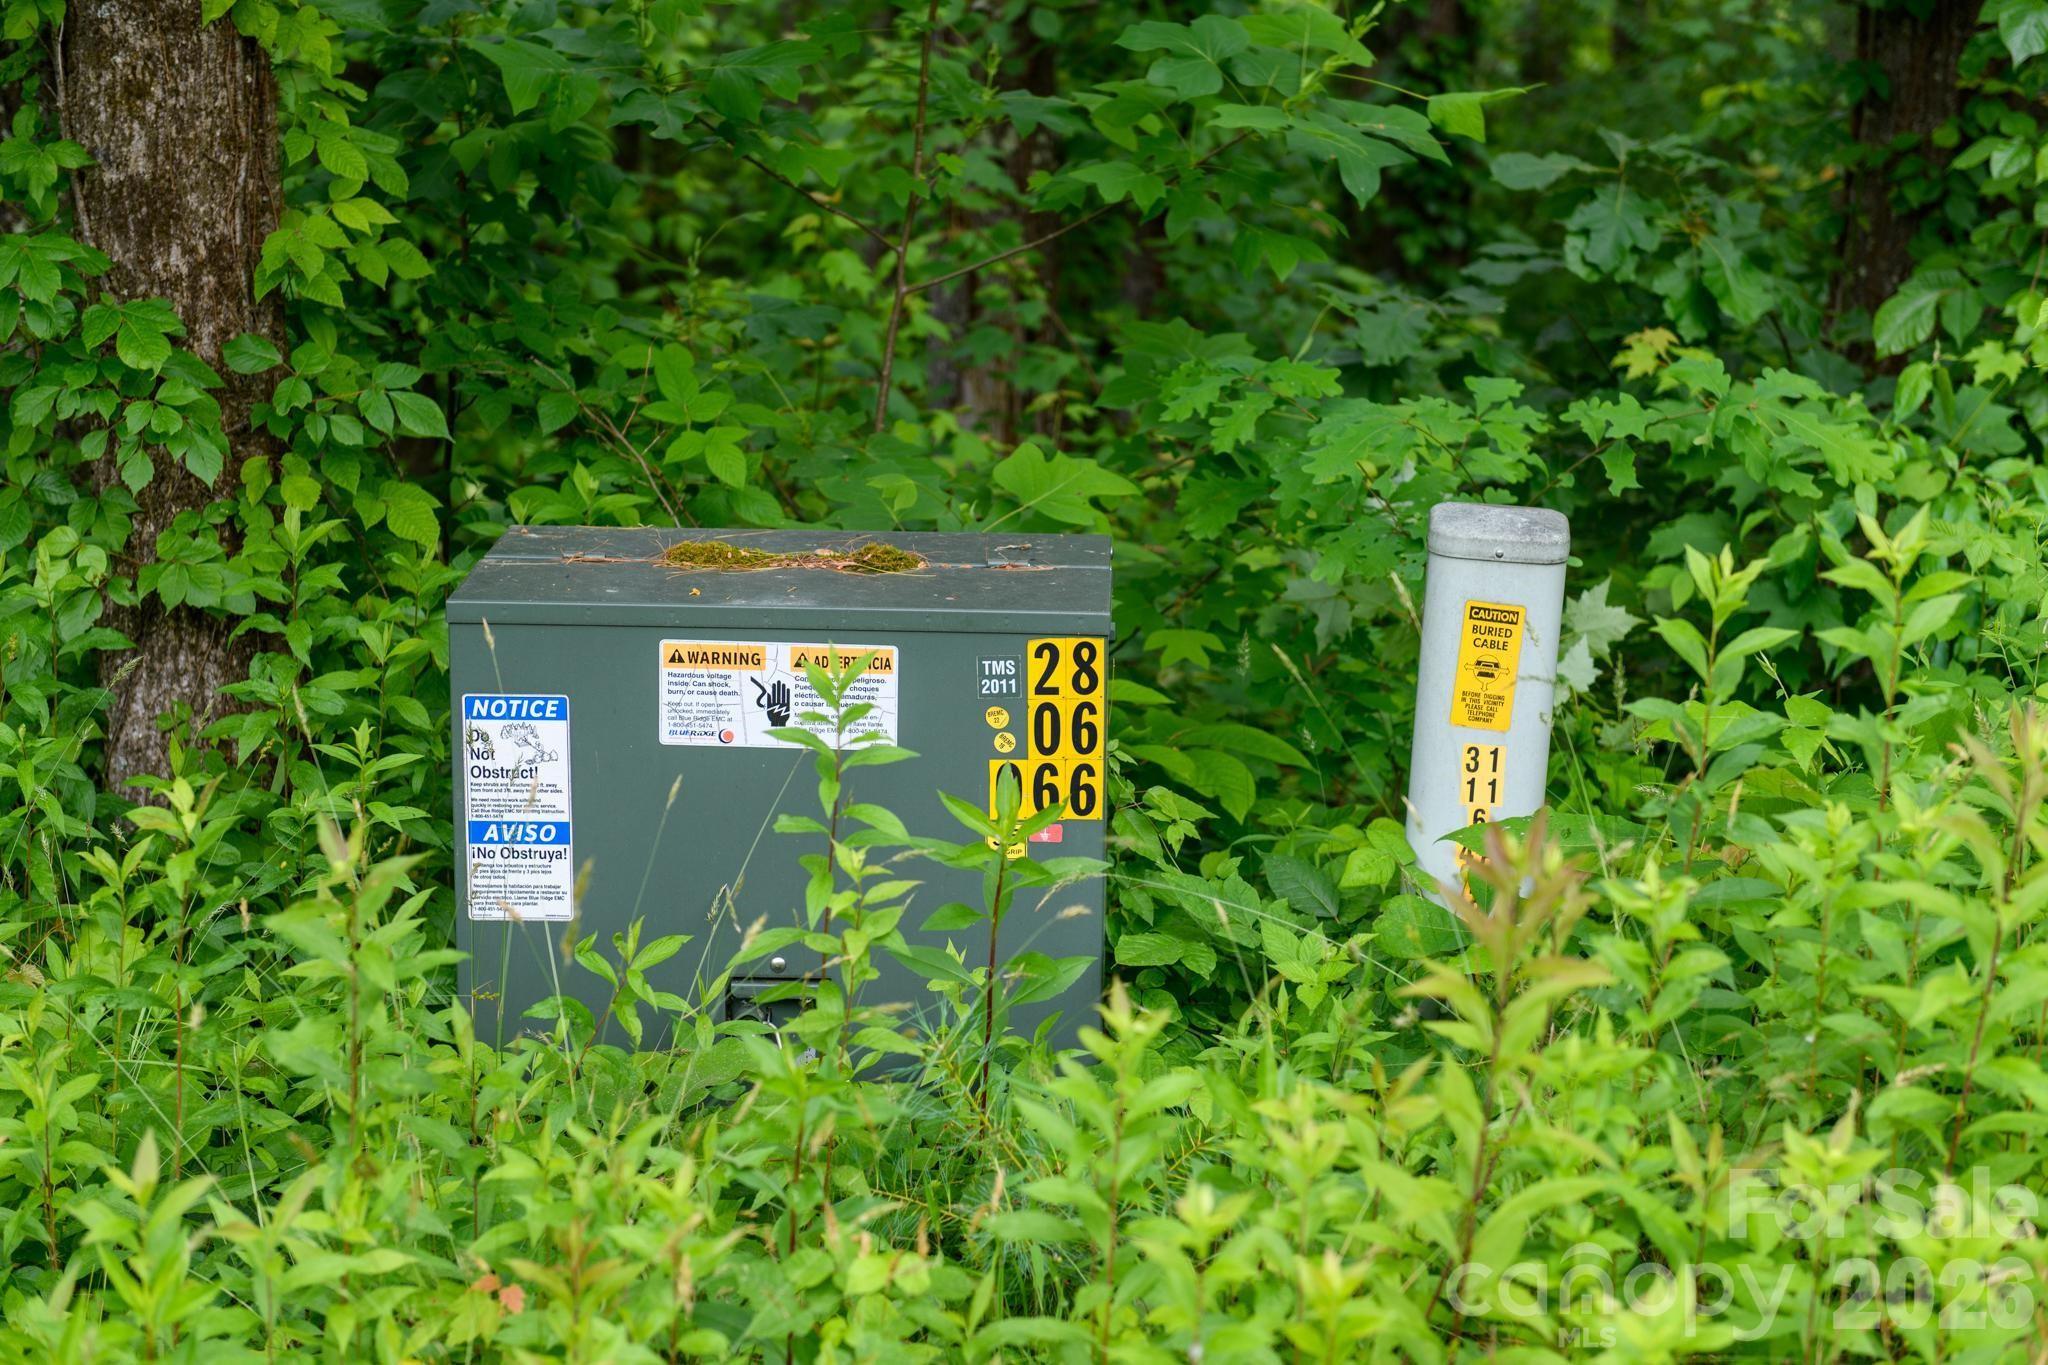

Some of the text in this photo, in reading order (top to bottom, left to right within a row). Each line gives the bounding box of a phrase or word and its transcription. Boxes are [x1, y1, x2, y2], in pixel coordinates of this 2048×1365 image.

[1471, 608, 1518, 623] CAUTION
[1472, 624, 1513, 639] BURIED
[1473, 638, 1509, 651] CABLE
[687, 651, 761, 666] WARNING
[982, 660, 1016, 675] TMS
[1034, 641, 1099, 696] 28
[981, 678, 1016, 695] 2011
[1484, 693, 1505, 701] DIGGING
[472, 699, 559, 718] NOTICE
[1468, 710, 1496, 718] TELEPHONE
[1468, 716, 1494, 724] COMPANY
[1034, 701, 1098, 757] 06
[470, 747, 496, 761] Not
[482, 824, 557, 842] AVISO
[500, 847, 568, 863] Obstruya!
